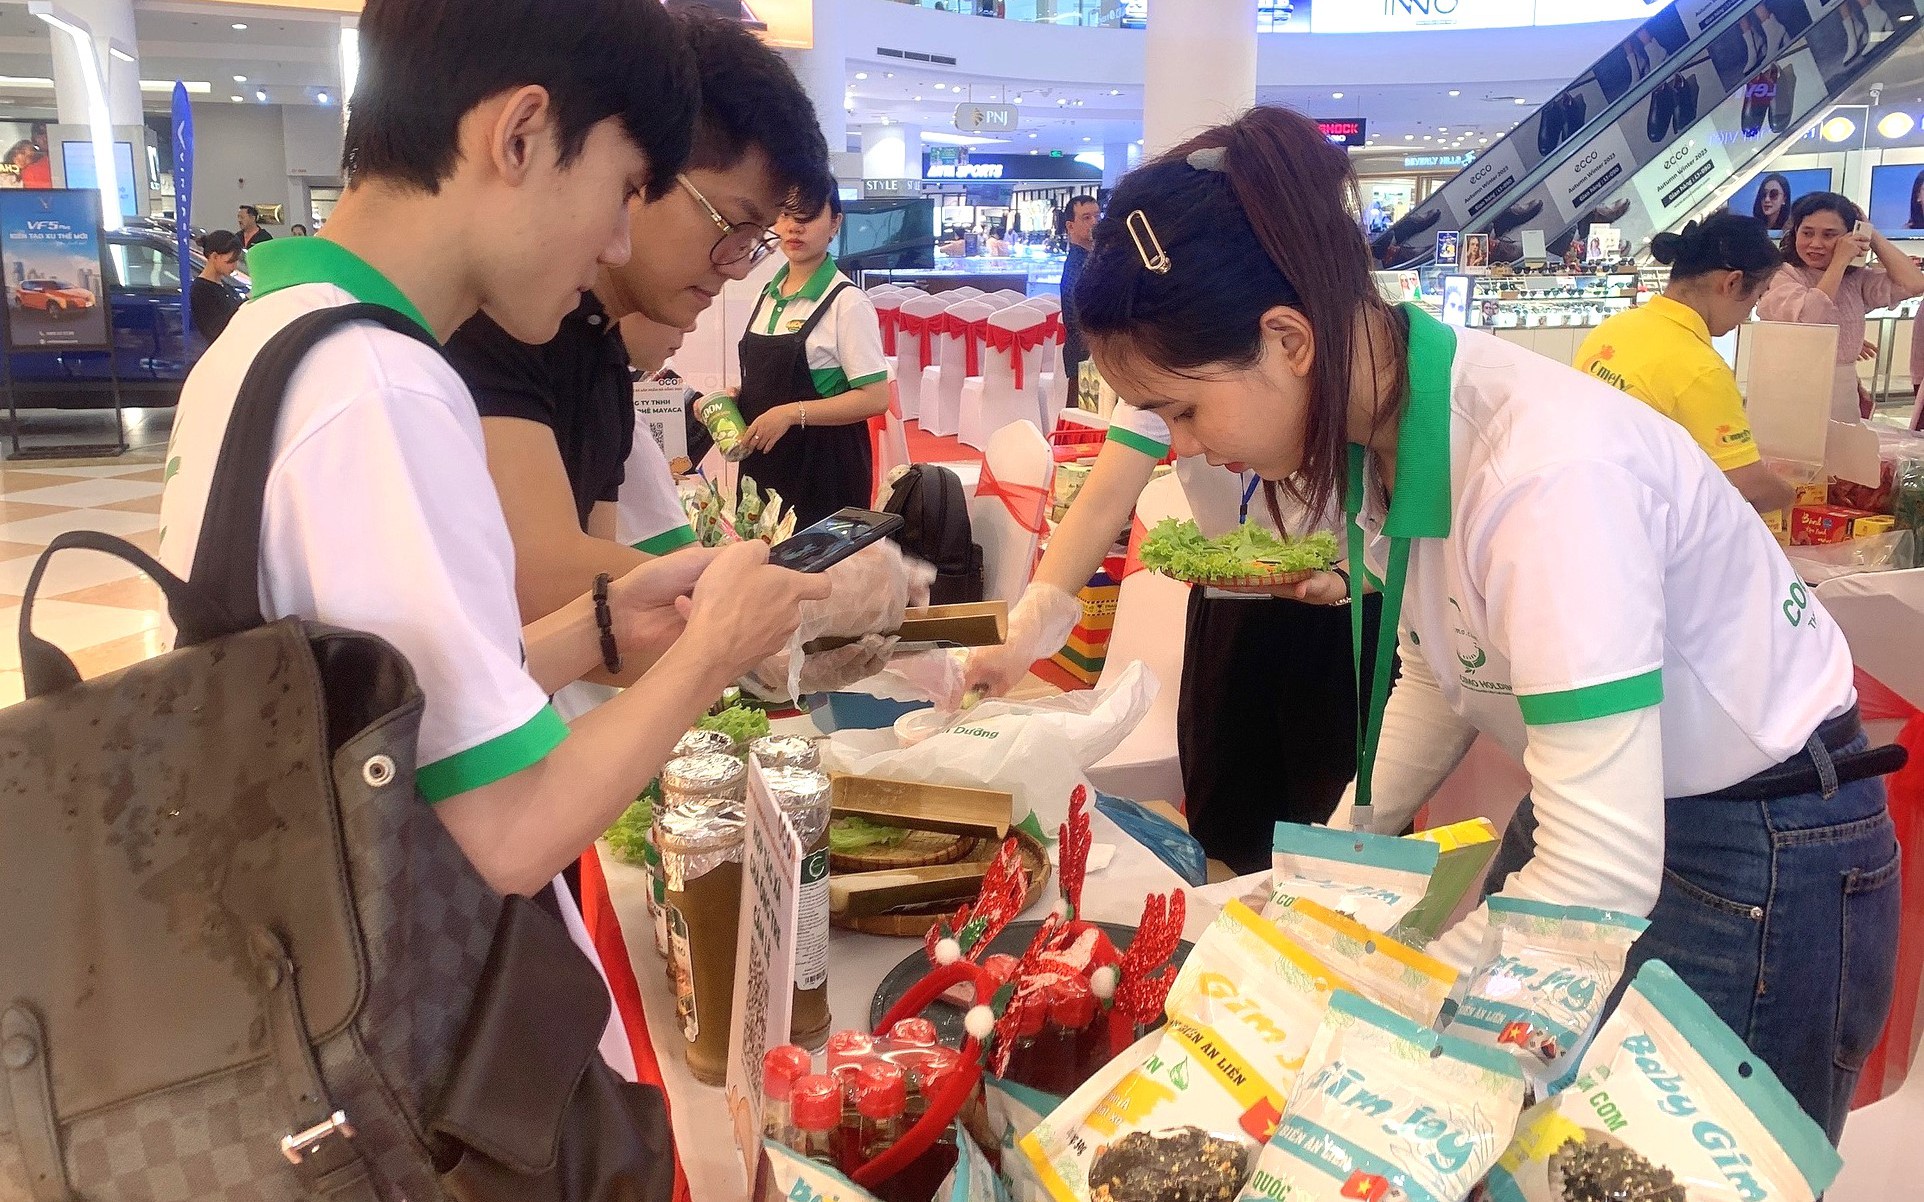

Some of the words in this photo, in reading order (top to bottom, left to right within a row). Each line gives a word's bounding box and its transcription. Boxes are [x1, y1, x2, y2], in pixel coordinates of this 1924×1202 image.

[986, 111, 1008, 125] PNJ
[866, 181, 898, 190] STYLE
[1657, 173, 1678, 192] Autumn
[1677, 159, 1695, 175] Winter
[1783, 574, 1807, 627] CO
[1621, 1033, 1698, 1118] Baby
